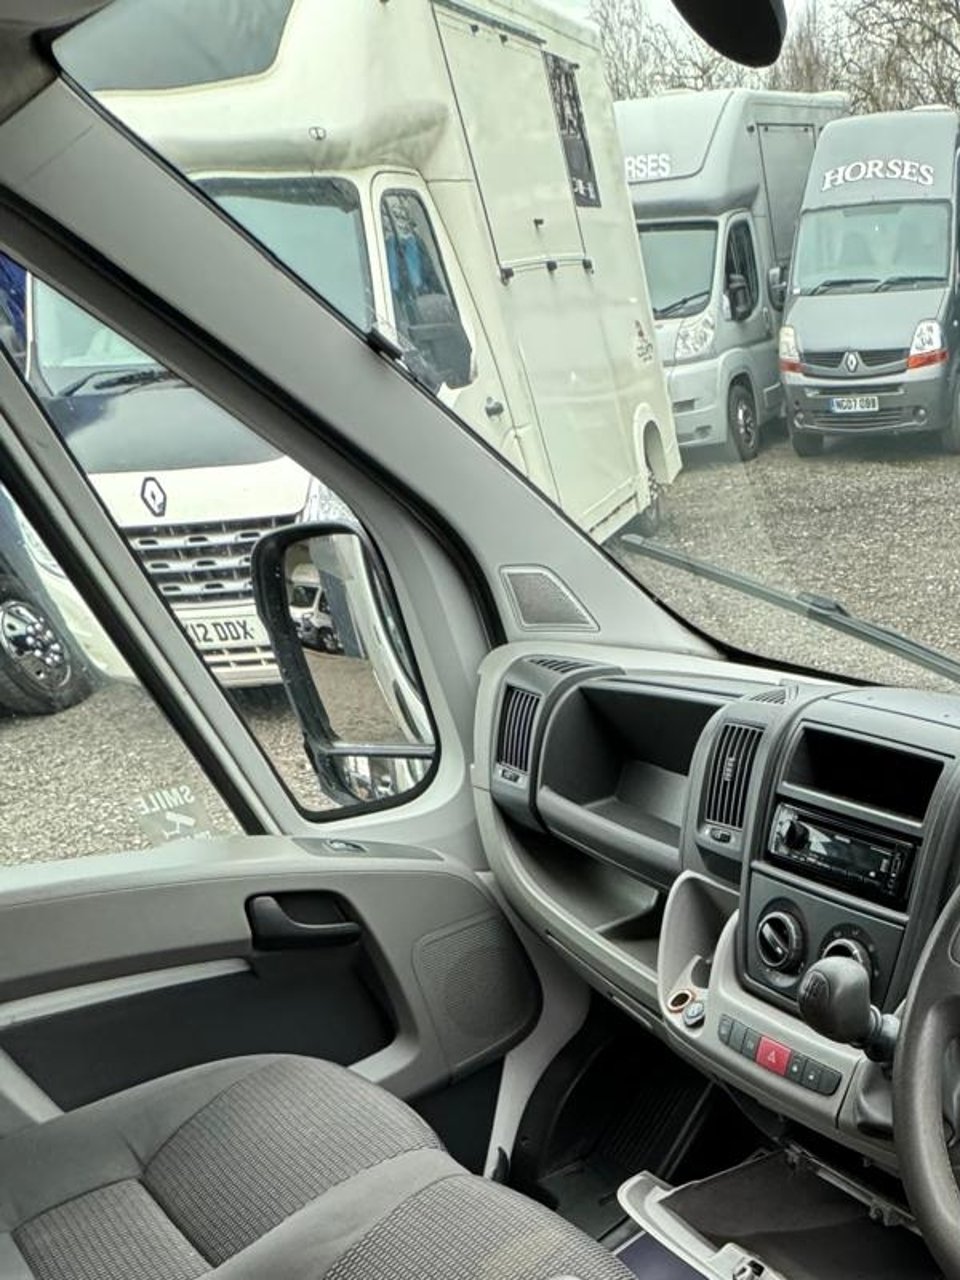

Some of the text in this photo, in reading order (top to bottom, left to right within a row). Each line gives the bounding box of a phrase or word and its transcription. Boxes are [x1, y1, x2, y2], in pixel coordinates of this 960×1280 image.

[624, 153, 671, 178] RSES
[820, 159, 935, 192] HORSES
[186, 620, 254, 642] 12 DDX
